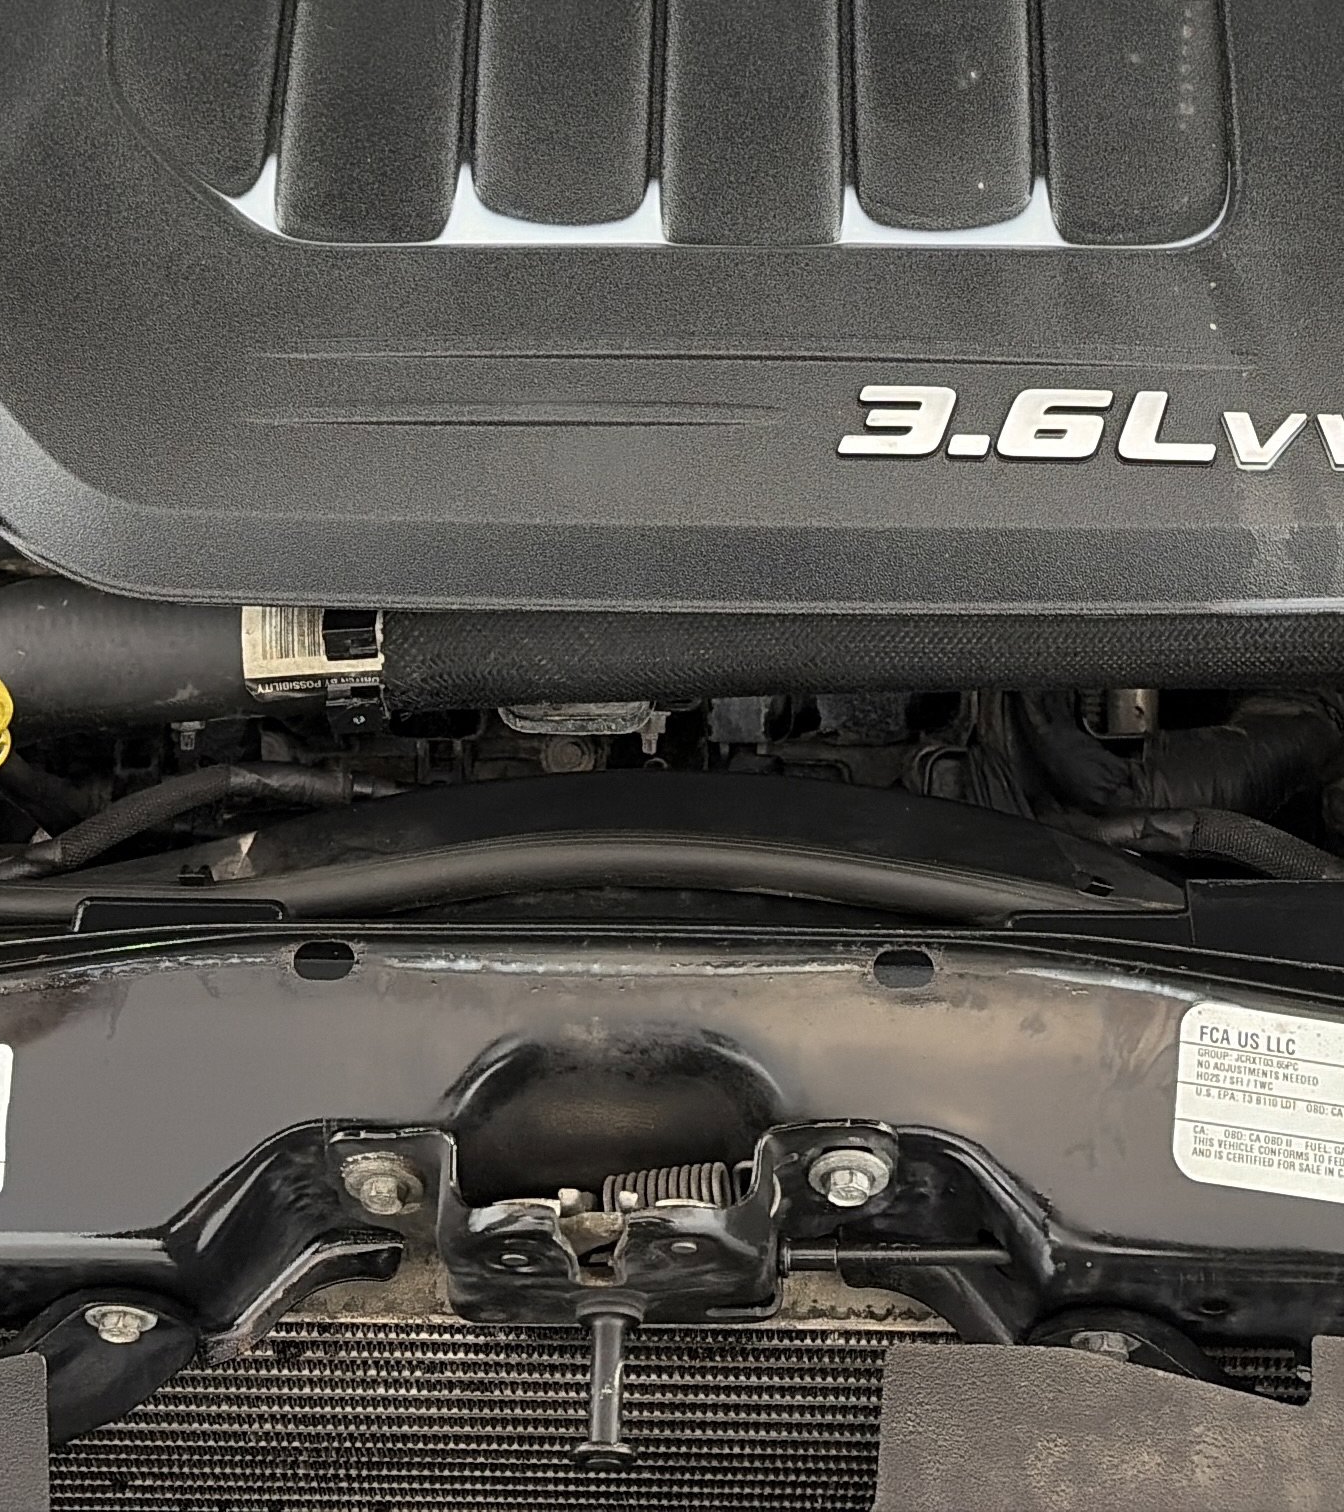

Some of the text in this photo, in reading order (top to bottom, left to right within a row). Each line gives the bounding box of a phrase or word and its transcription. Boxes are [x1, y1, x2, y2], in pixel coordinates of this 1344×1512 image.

[836, 385, 1218, 466] 3.6L
[256, 680, 322, 694] POSSIBILITY
[1199, 1025, 1296, 1055] FCA US LLC
[1197, 1048, 1233, 1061] GROUP:
[1196, 1060, 1319, 1086] NO ADJUSTMENTS NEEDED
[1229, 1076, 1244, 1086] SFI
[1253, 1080, 1274, 1091] TWC
[1195, 1087, 1215, 1098] U.S.
[1217, 1090, 1240, 1102] EPA:
[1306, 1103, 1329, 1115] OBD:
[1330, 1107, 1344, 1118] CA
[1193, 1125, 1209, 1135] CA:
[1224, 1129, 1246, 1139] OBD:
[1249, 1133, 1261, 1143] CA
[1264, 1135, 1283, 1146] OBD
[1305, 1141, 1332, 1154] FUEL:
[1193, 1136, 1214, 1147] THIS
[1217, 1140, 1254, 1154] VEHICLE
[1258, 1145, 1308, 1161] CONFORMS
[1313, 1153, 1325, 1163] TO
[1192, 1147, 1211, 1158] AND
[1214, 1150, 1223, 1160] IS
[1226, 1152, 1274, 1167] CERTIFIED
[1277, 1159, 1296, 1171] FOR
[1299, 1163, 1321, 1175] SALE
[1325, 1166, 1334, 1176] IN
